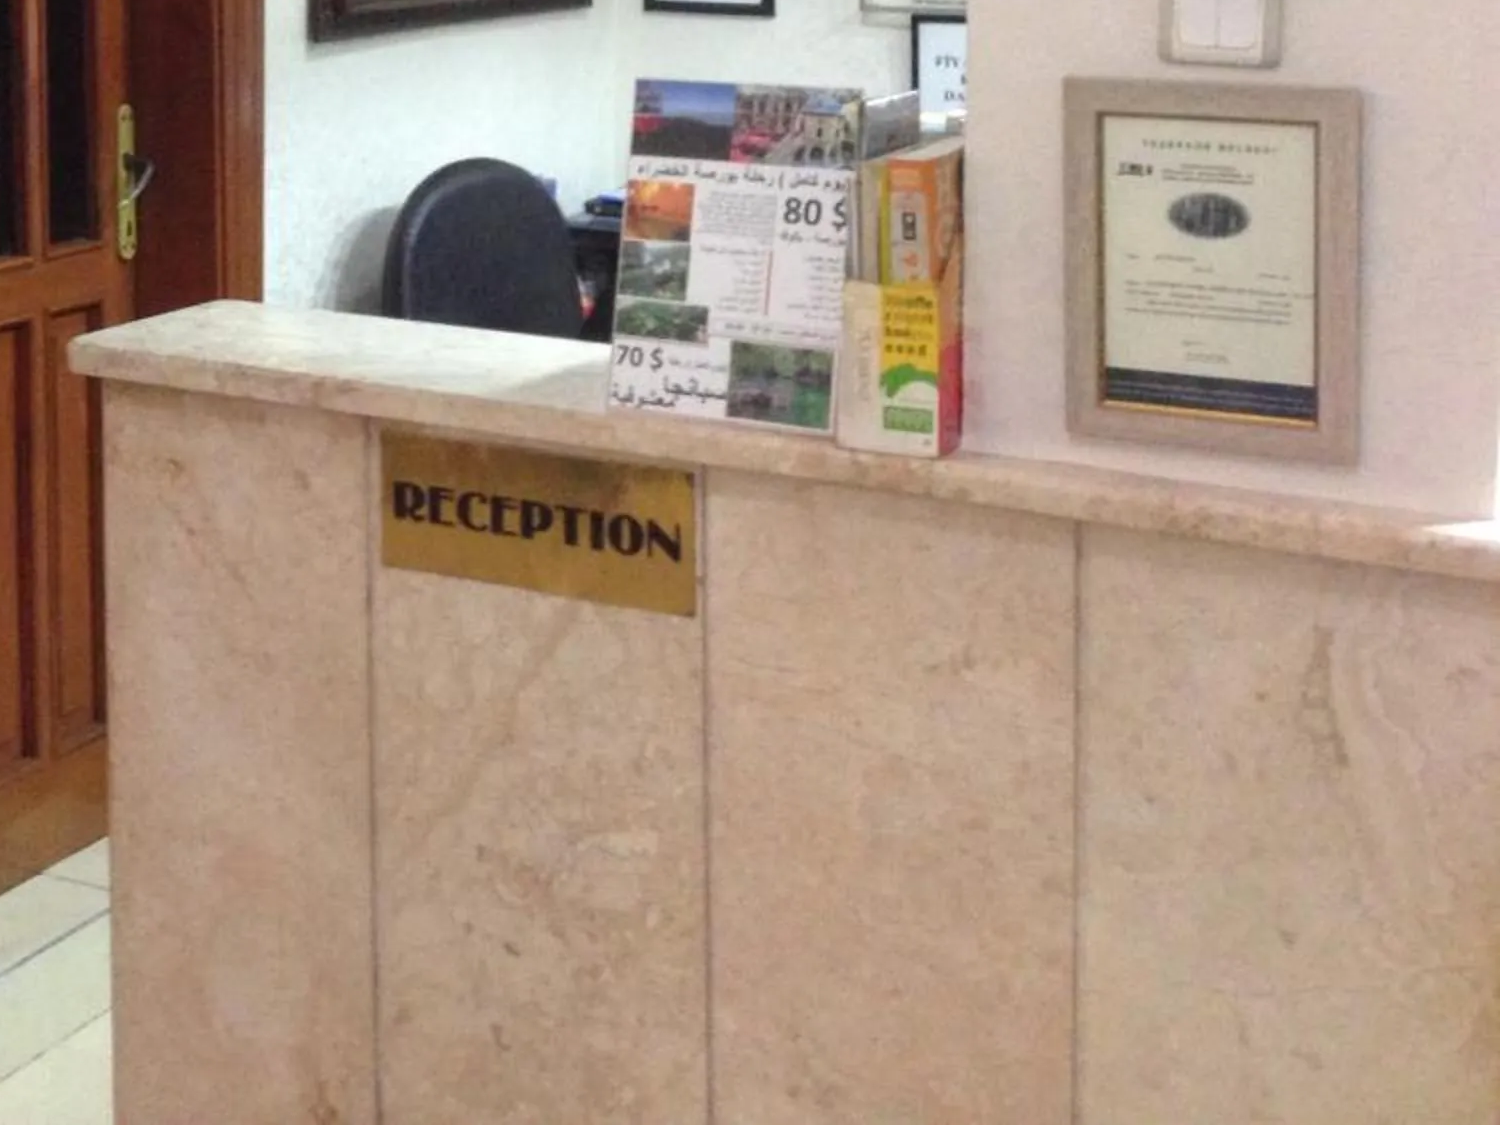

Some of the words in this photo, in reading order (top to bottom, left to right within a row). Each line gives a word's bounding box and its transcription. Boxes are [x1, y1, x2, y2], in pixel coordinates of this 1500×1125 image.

[783, 197, 822, 226] 80
[616, 345, 643, 367] 70
[649, 346, 664, 373] $
[392, 480, 682, 564] RECEPTION
